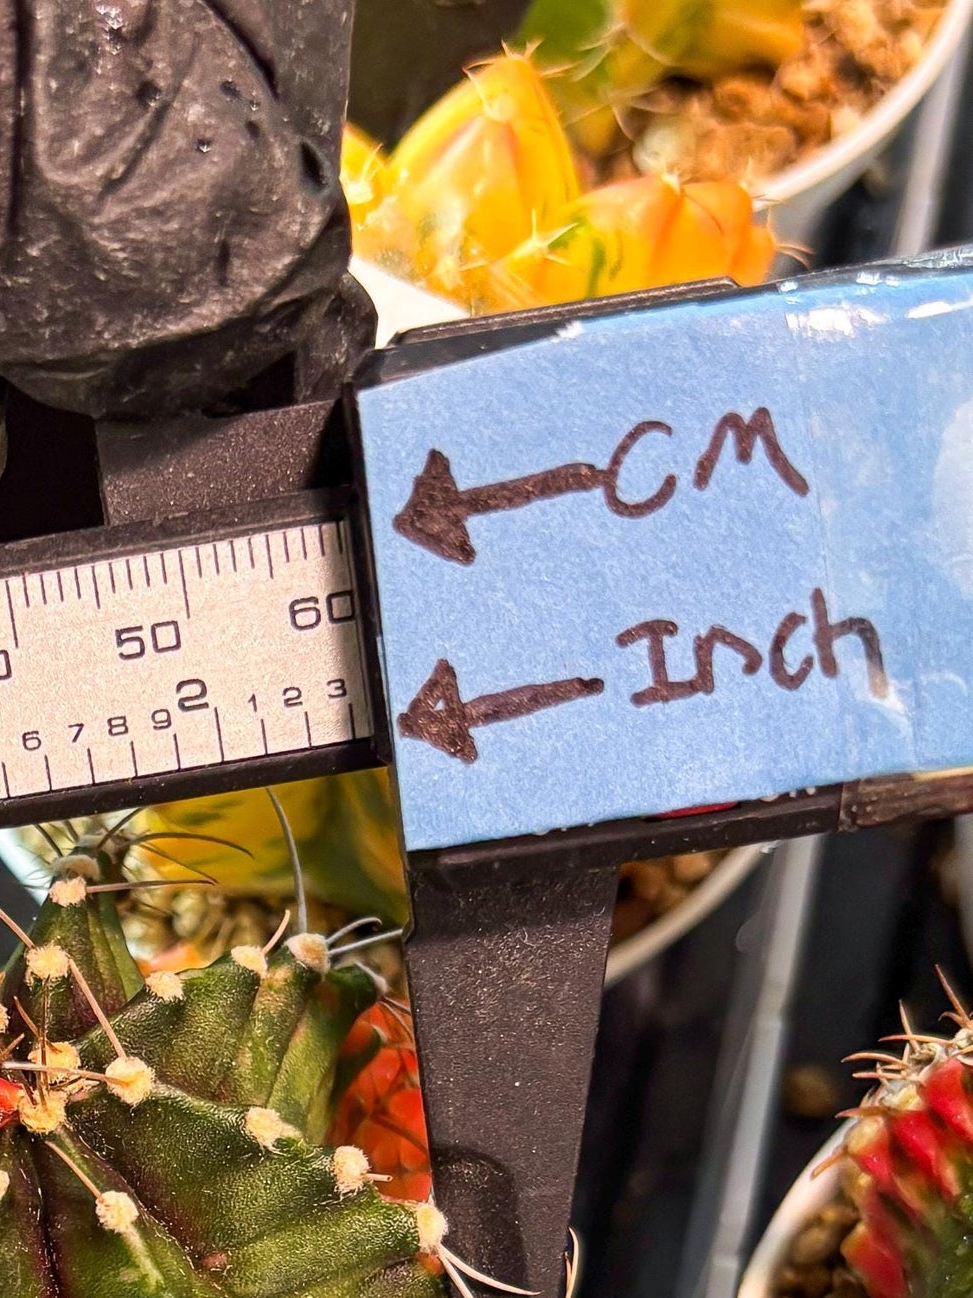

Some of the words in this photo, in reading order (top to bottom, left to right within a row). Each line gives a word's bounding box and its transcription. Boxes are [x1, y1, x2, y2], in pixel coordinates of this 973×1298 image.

[604, 406, 810, 519] CM
[114, 619, 182, 661] 50
[288, 589, 357, 632] 60
[616, 587, 888, 708] Inch
[21, 730, 42, 752] 6
[67, 722, 85, 744] 7
[106, 715, 129, 737] 8
[150, 708, 173, 731] 9
[175, 677, 210, 713] 2
[247, 692, 258, 713] 1
[281, 686, 304, 709] 2
[326, 678, 348, 699] 3
